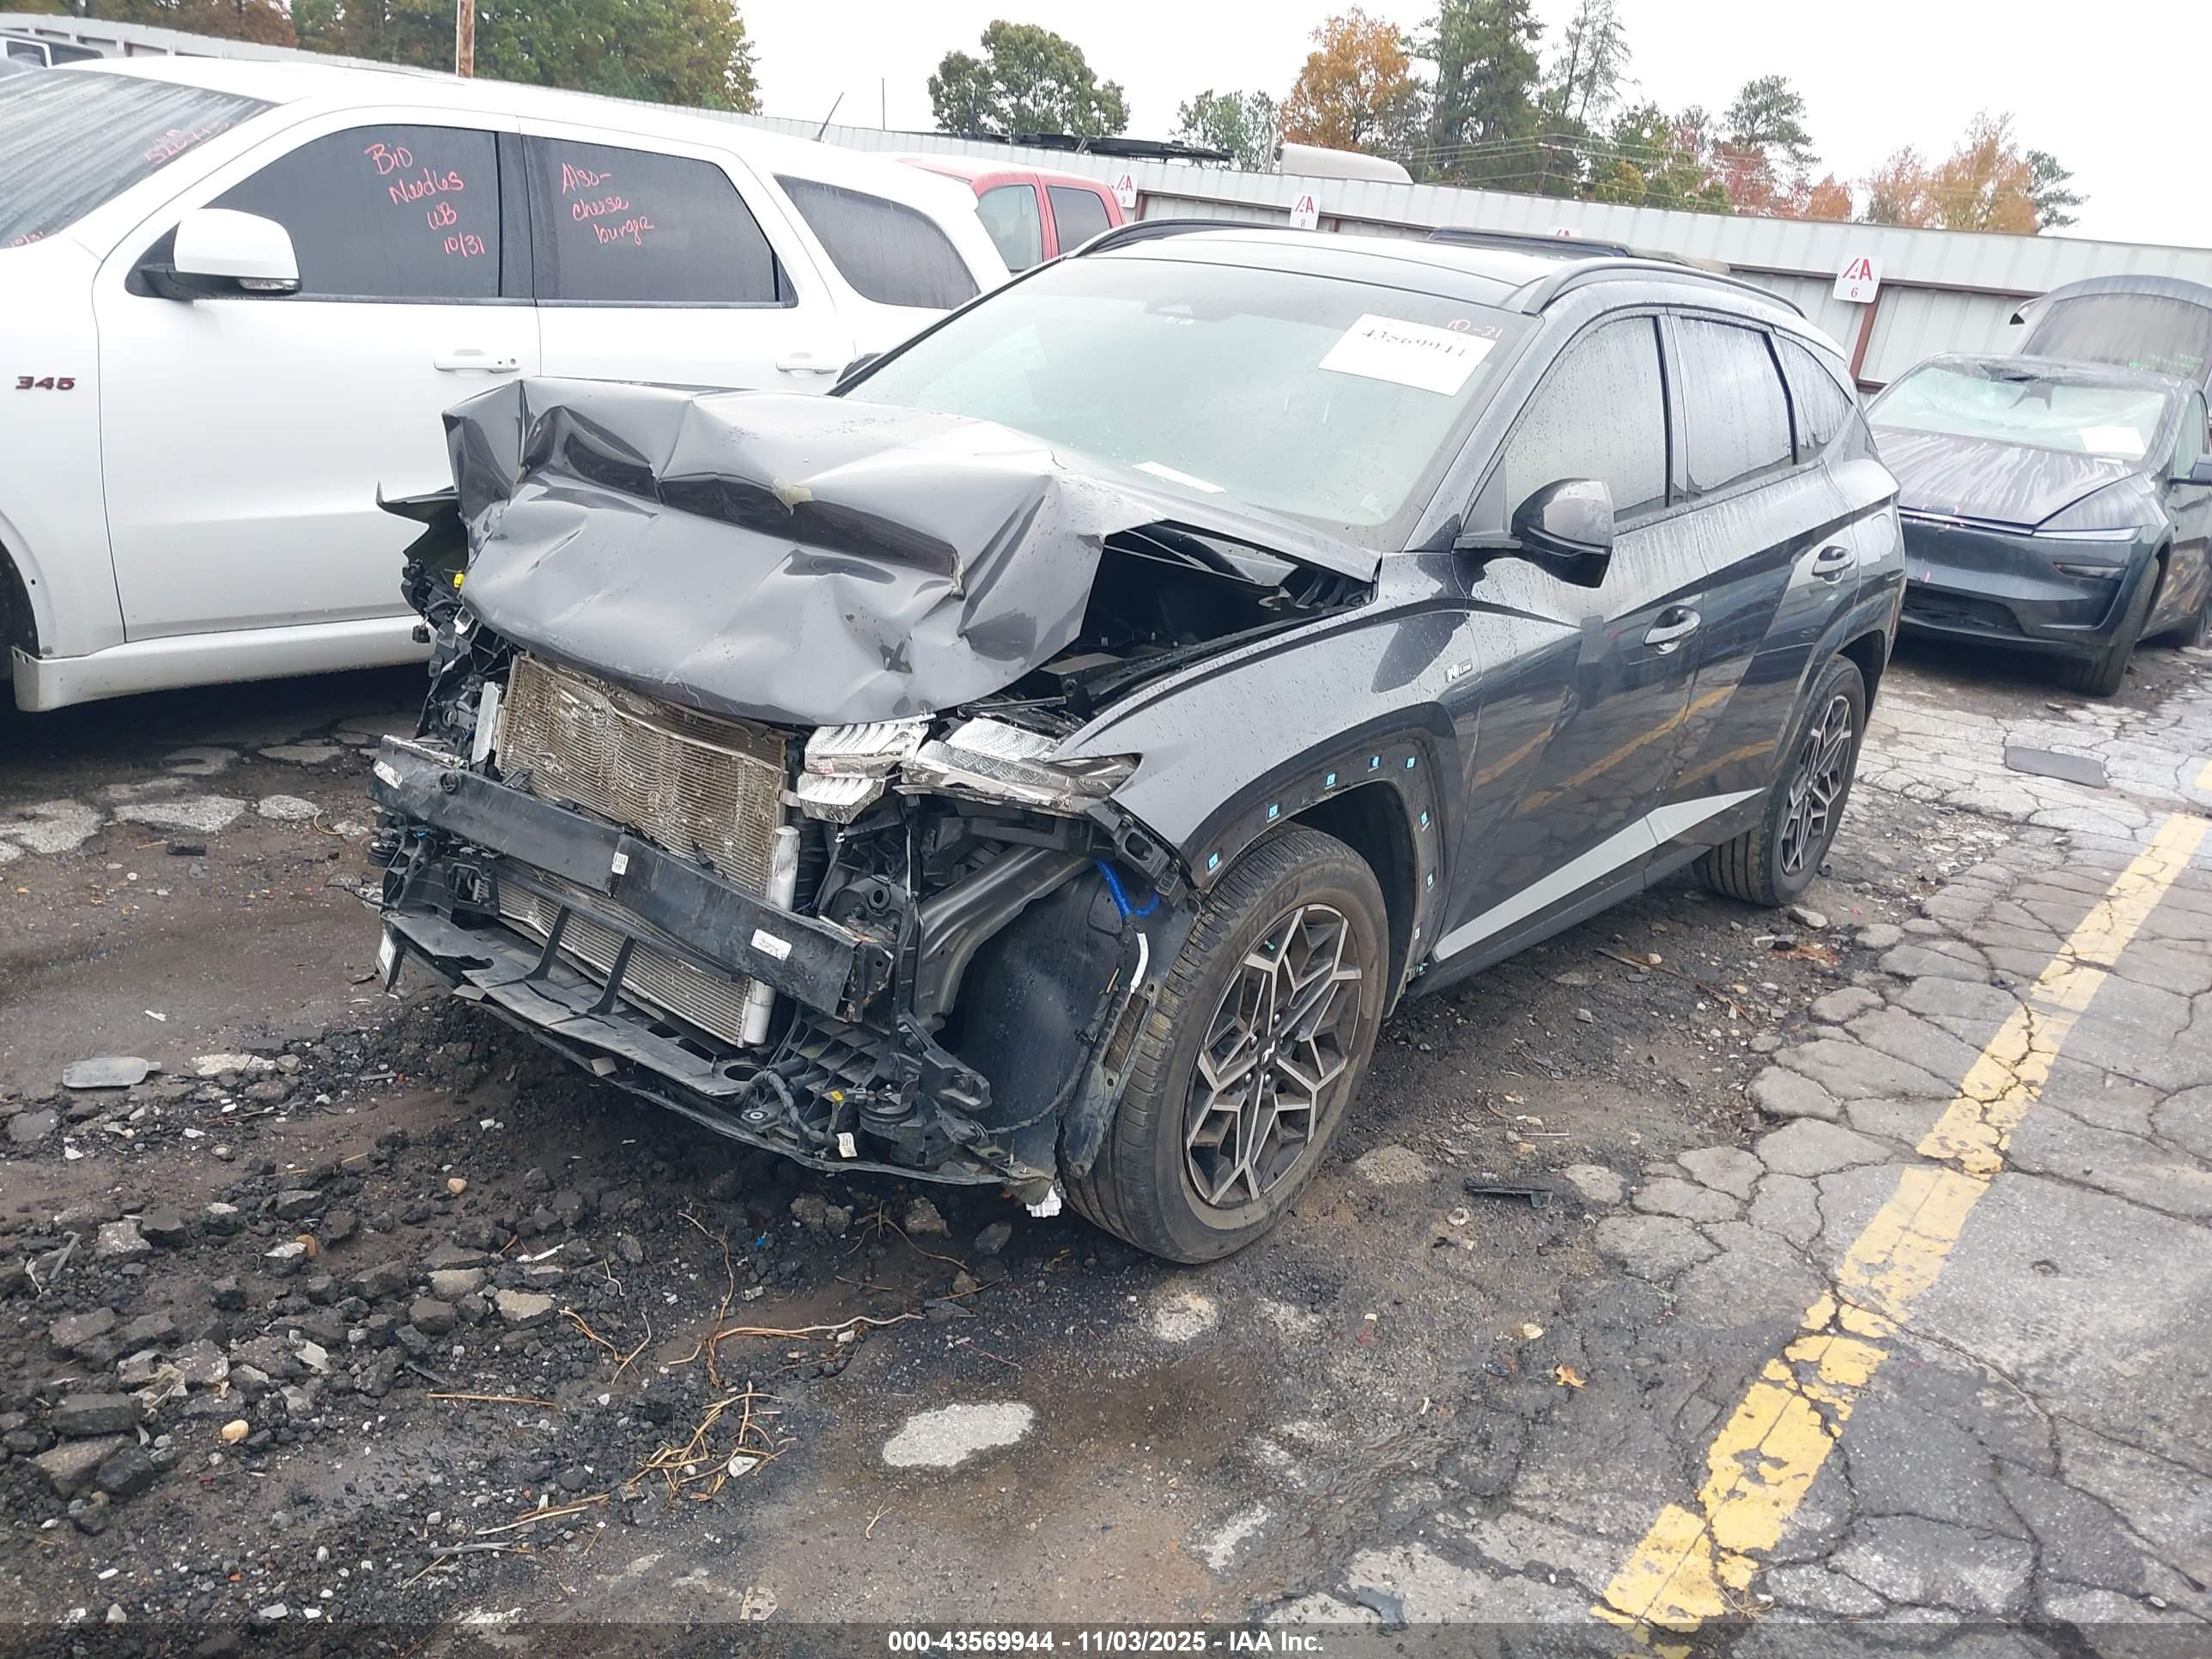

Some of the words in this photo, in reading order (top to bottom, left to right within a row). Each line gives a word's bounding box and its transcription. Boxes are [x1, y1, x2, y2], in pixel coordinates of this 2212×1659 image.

[389, 167, 465, 205] Needles
[1300, 218, 1305, 228] 8
[444, 231, 485, 258] 10/31
[1850, 287, 1859, 298] 6
[1446, 319, 1503, 338] 10-31
[15, 376, 76, 390] 345
